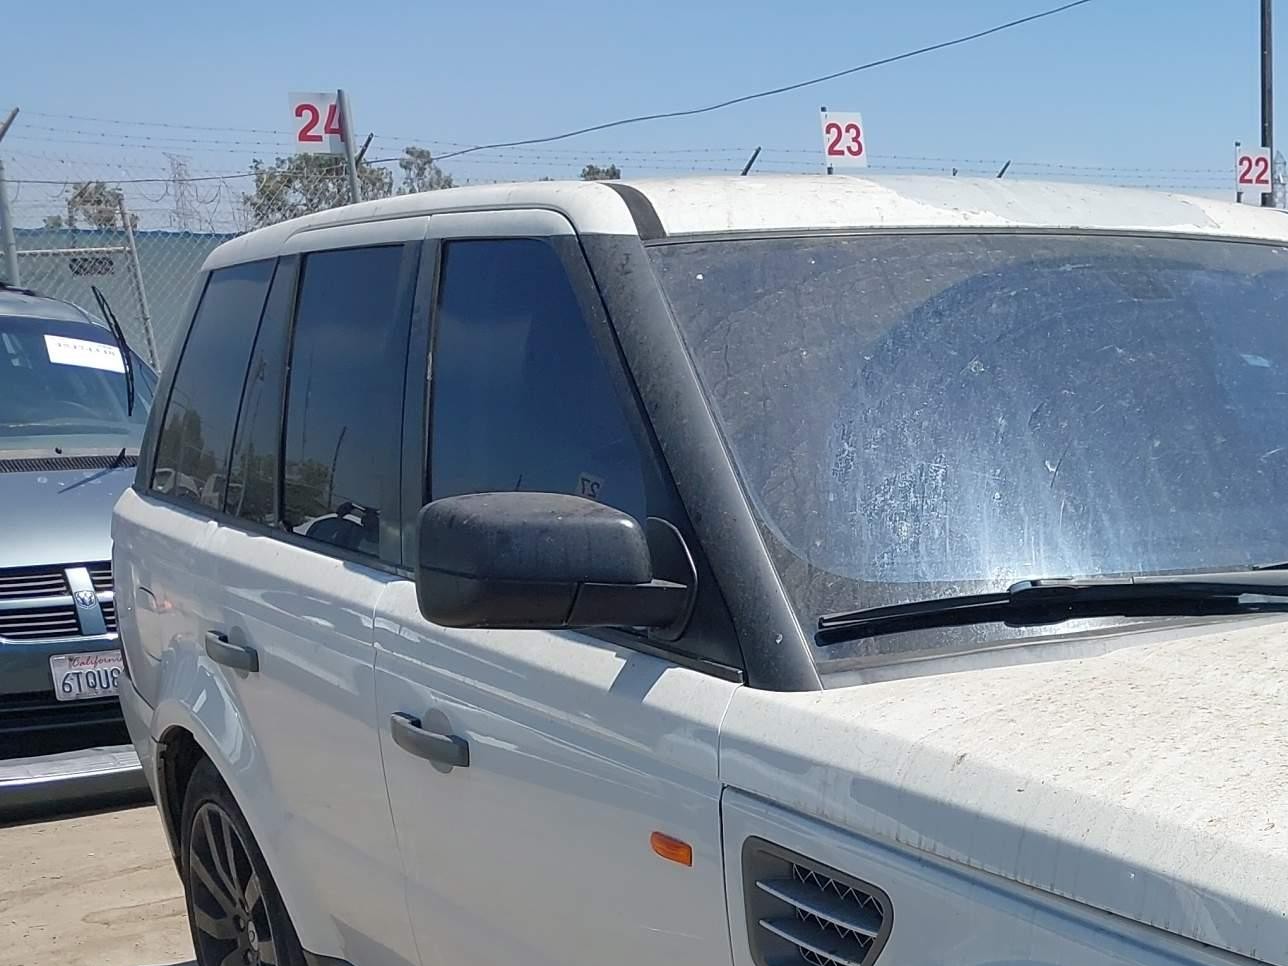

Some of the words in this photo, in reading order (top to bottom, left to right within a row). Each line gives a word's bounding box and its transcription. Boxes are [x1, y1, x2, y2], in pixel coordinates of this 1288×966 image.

[294, 103, 346, 142] 24
[825, 122, 863, 156] 23
[1238, 155, 1269, 184] 22
